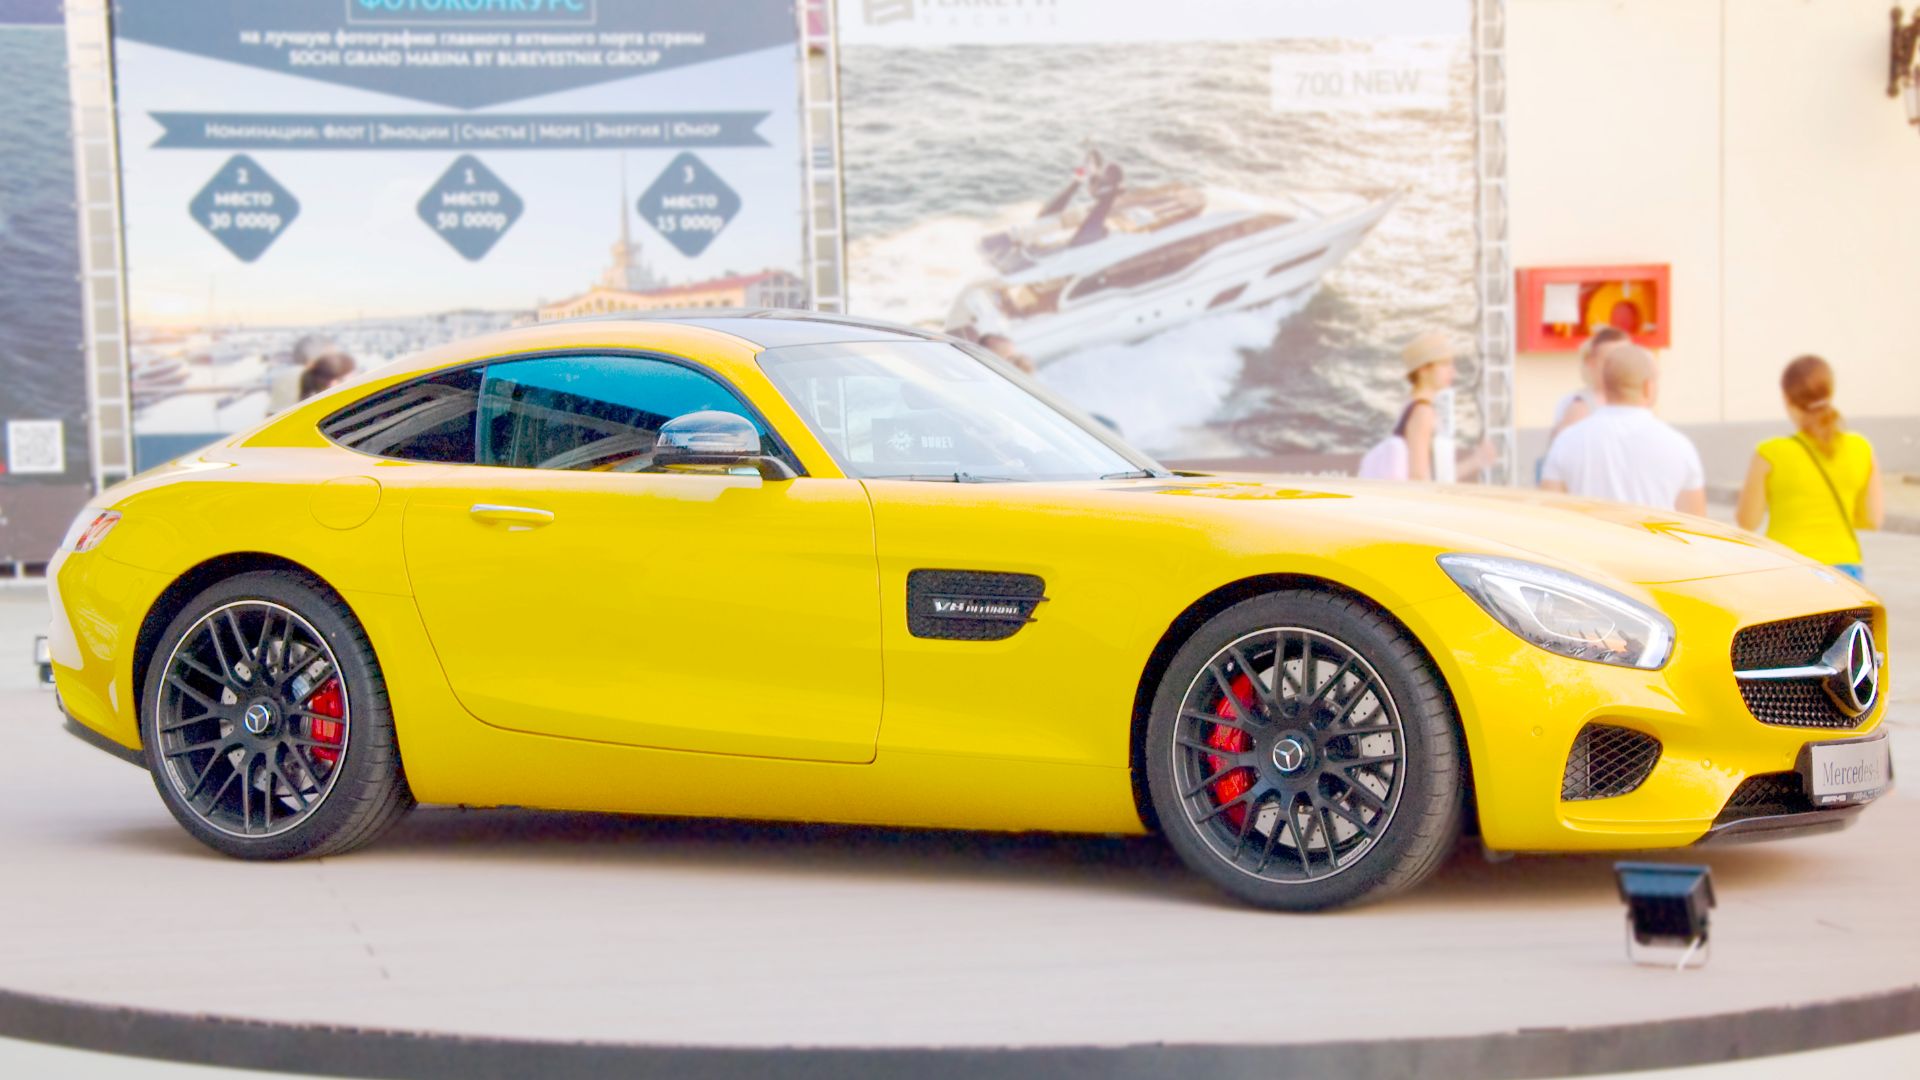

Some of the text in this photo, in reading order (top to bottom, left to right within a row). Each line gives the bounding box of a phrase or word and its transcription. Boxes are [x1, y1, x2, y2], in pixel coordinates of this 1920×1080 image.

[239, 27, 706, 49] на лучшую фотографию главного яхтенного порта страны
[289, 50, 661, 66] SOCHI GRAND MARINA BY BUREVESTNIK GROUP
[1293, 68, 1421, 98] 700 NEW
[237, 167, 249, 185] 2
[464, 167, 476, 185] 1
[683, 164, 696, 184] 3
[209, 212, 231, 230] 30
[437, 212, 458, 230] 50
[657, 214, 676, 233] 15
